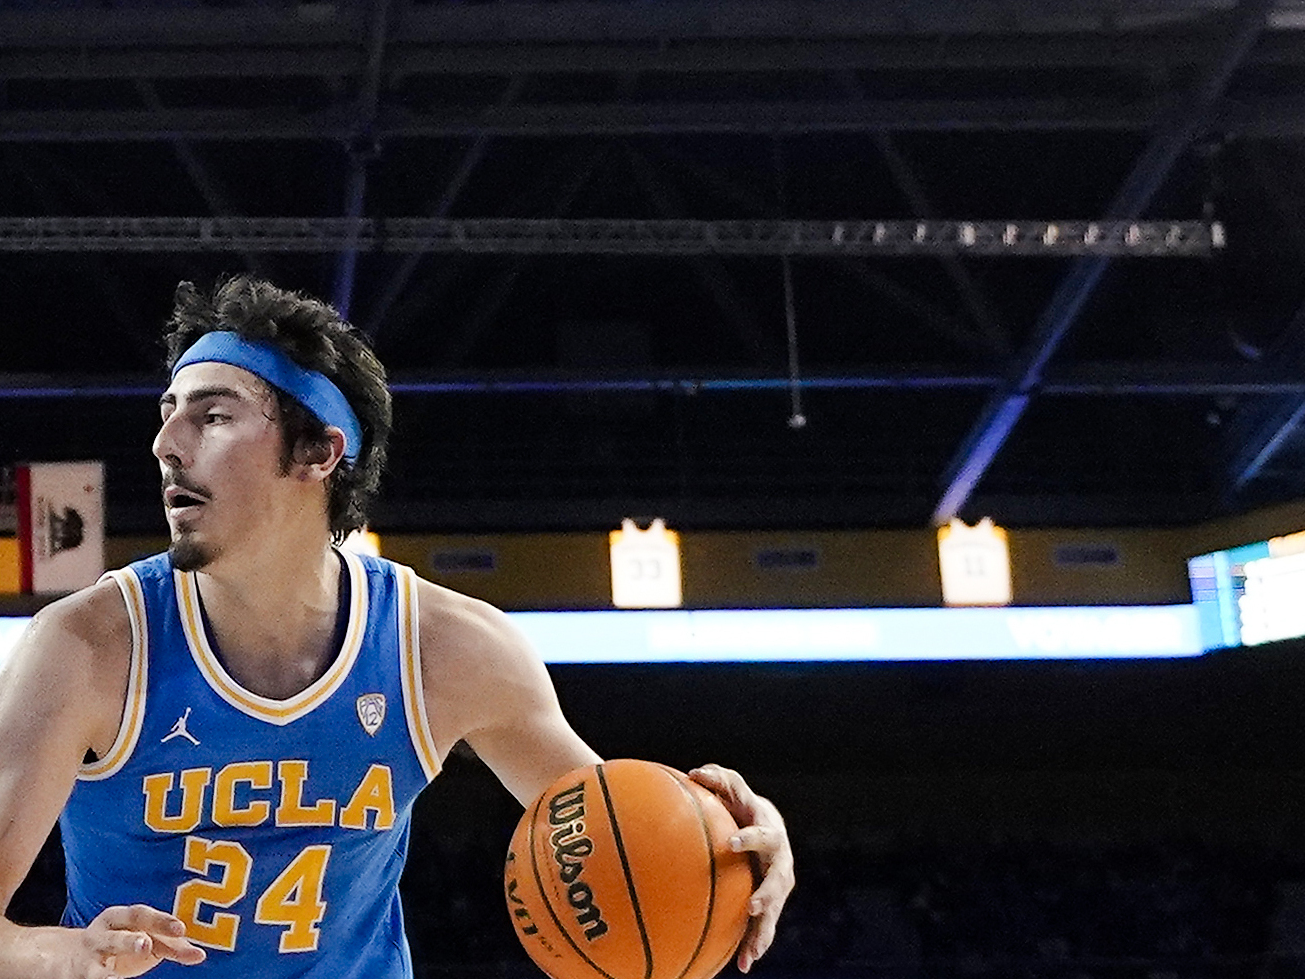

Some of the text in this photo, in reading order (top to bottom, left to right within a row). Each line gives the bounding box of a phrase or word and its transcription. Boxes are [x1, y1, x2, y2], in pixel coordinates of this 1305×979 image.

[143, 760, 396, 833] UCLA
[173, 836, 333, 953] 24
[548, 781, 610, 942] Wilson
